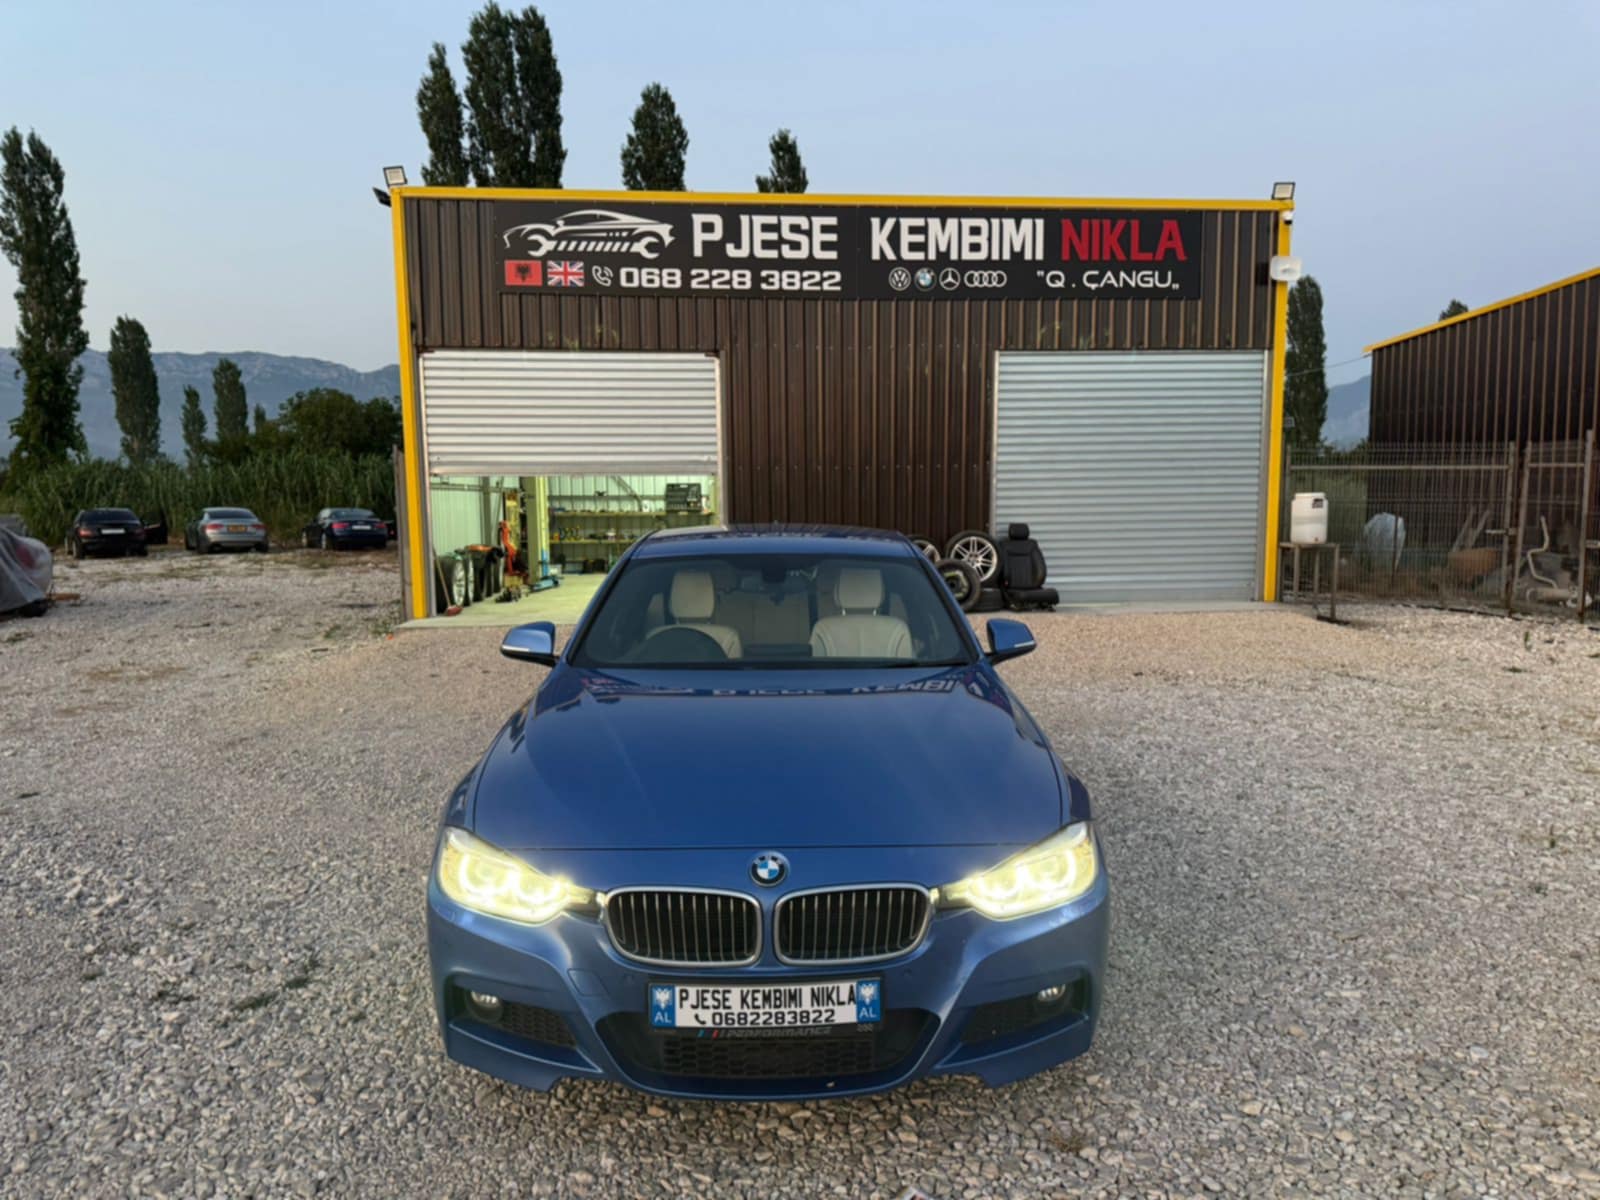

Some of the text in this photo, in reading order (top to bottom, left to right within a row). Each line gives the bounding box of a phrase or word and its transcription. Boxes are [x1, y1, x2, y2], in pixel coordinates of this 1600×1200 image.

[870, 216, 1045, 261] KEMBIMI
[1060, 218, 1188, 262] NIKLA
[619, 266, 842, 291] 068 228 3822
[740, 986, 803, 1010] KEMBIMI
[810, 983, 857, 1008] NIKLA
[654, 1011, 671, 1024] AL
[711, 1008, 836, 1026] 0682283822
[859, 1007, 877, 1019] AL
